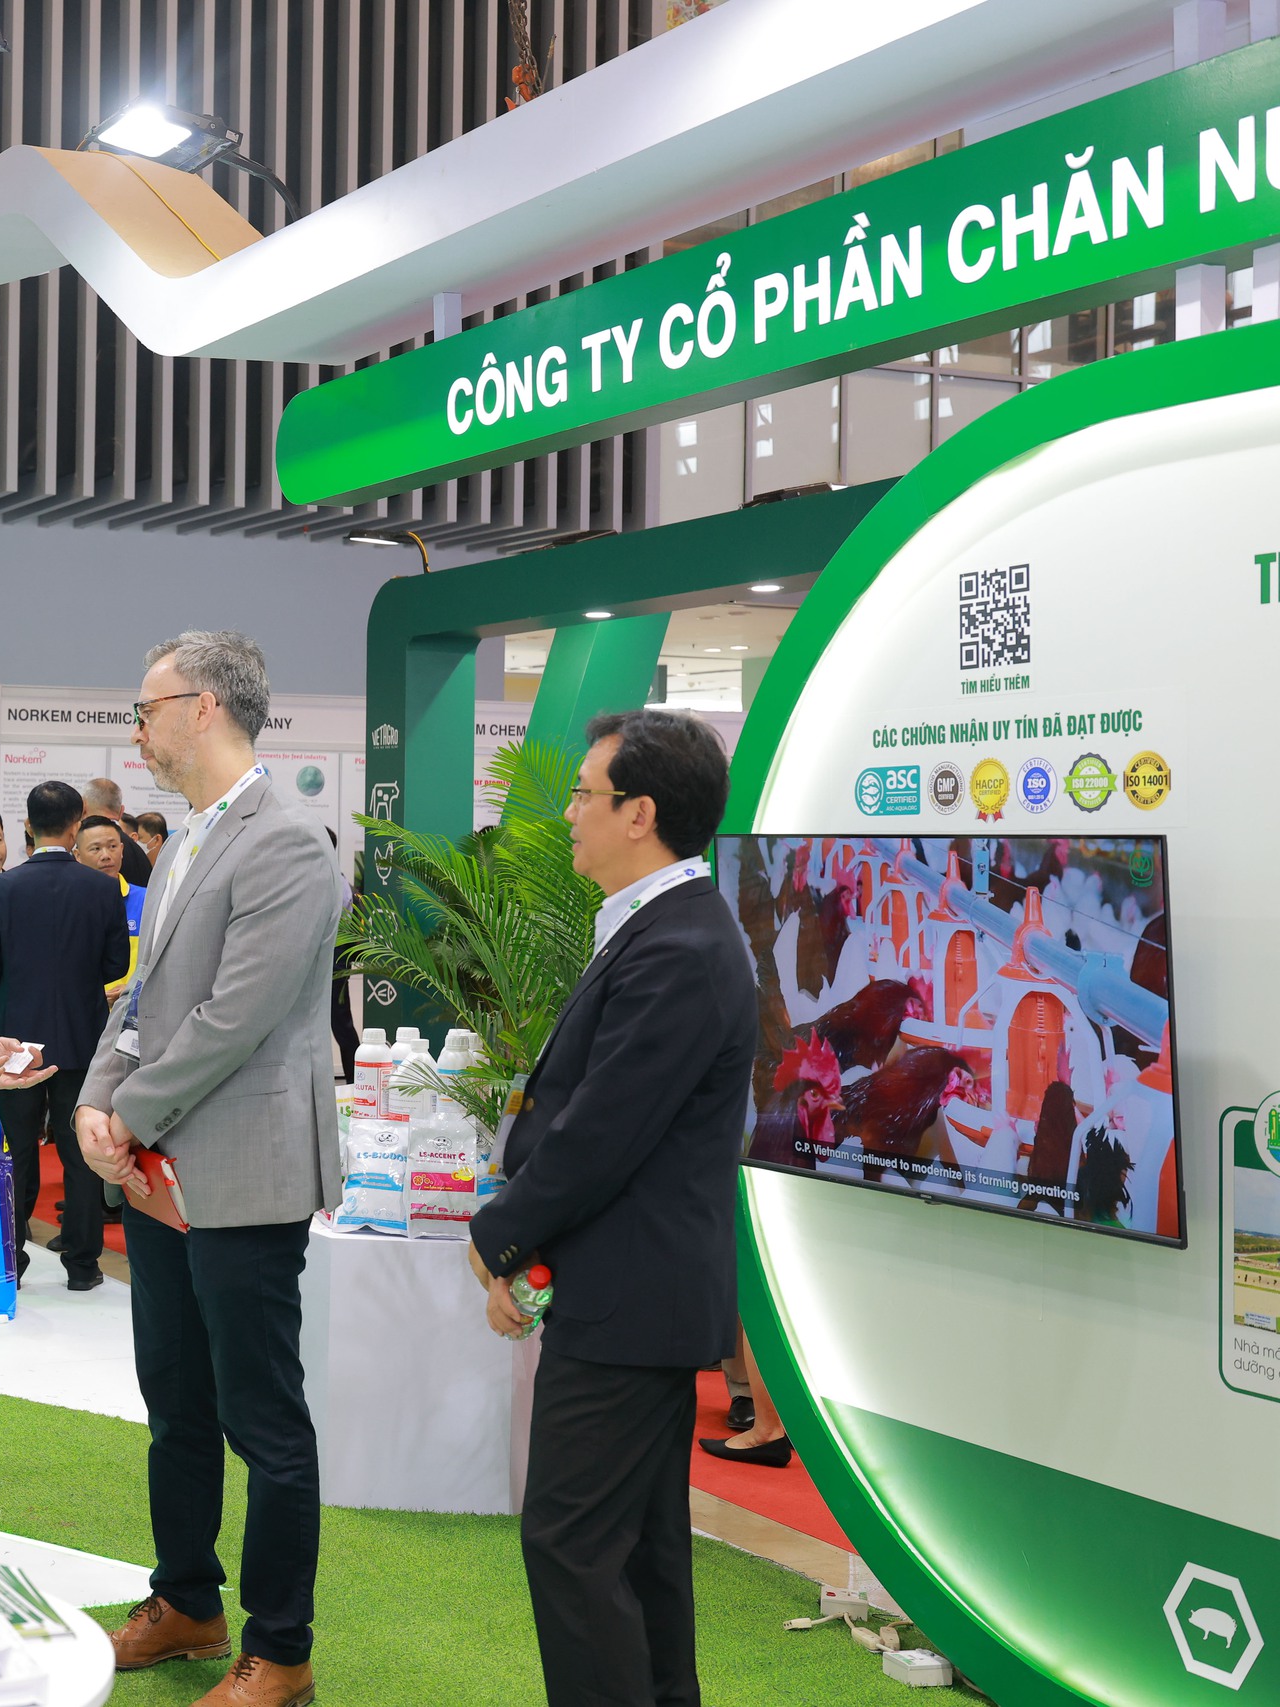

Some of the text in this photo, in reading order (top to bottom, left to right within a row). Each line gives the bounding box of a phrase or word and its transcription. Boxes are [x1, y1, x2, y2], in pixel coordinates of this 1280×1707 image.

[447, 352, 569, 436] CÔNG
[581, 318, 645, 394] TY
[659, 252, 737, 371] CỔ
[754, 212, 923, 344] PHẦN
[946, 146, 1165, 285] CHĂN
[961, 673, 1030, 695] TÌM HIỂU THÊM
[8, 708, 72, 723] NORKEM
[873, 709, 1143, 749] CÁC CHỨNG NHẬN UY TÍN ĐÃ ĐẠT ĐƯỢC
[5, 754, 42, 764] Norkem
[124, 761, 146, 769] What
[937, 777, 956, 792] GMP
[976, 778, 1004, 790] HACCP
[1027, 778, 1047, 788] ISO
[1072, 777, 1108, 789] ISO 22000
[1127, 774, 1168, 787] ISO 14001
[886, 796, 917, 804] CERTIFIED
[458, 1152, 466, 1161] C
[795, 1141, 1080, 1202] C.P. Vietnam continued to modernize its farming operations
[1233, 1336, 1259, 1356] Nhà
[1233, 1357, 1275, 1381] dưỡng
